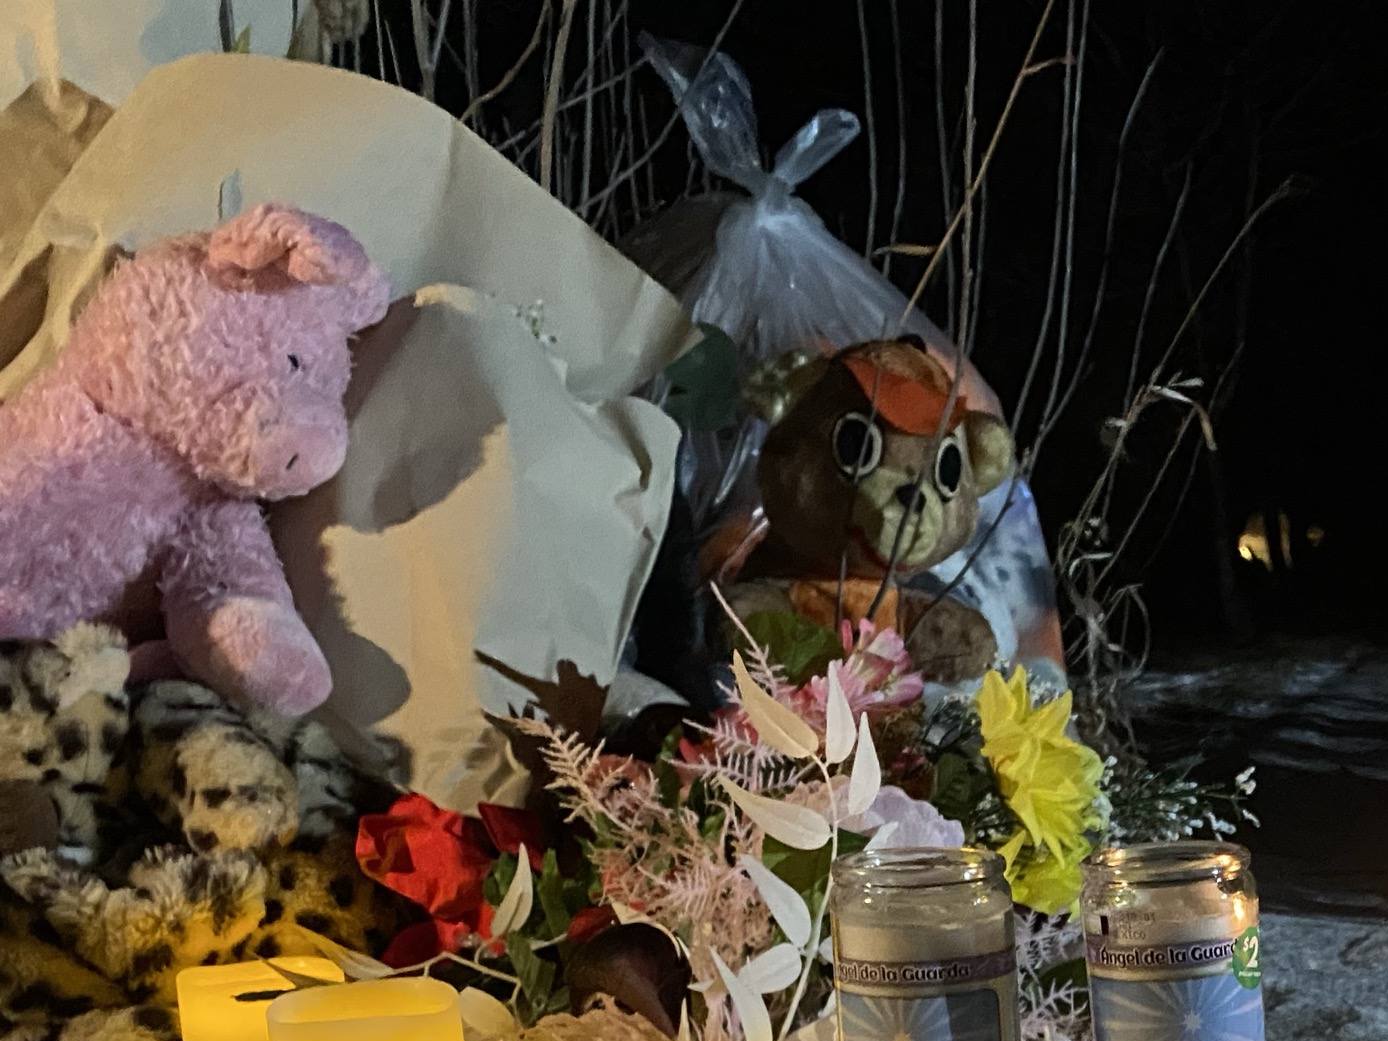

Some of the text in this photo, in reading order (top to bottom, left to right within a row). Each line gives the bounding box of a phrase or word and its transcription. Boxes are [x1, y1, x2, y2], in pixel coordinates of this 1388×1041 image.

[1101, 939, 1237, 968] Ángel de la Guard
[1243, 936, 1259, 967] $2
[861, 966, 877, 981] de
[882, 965, 897, 981] la
[901, 963, 970, 982] Guarda
